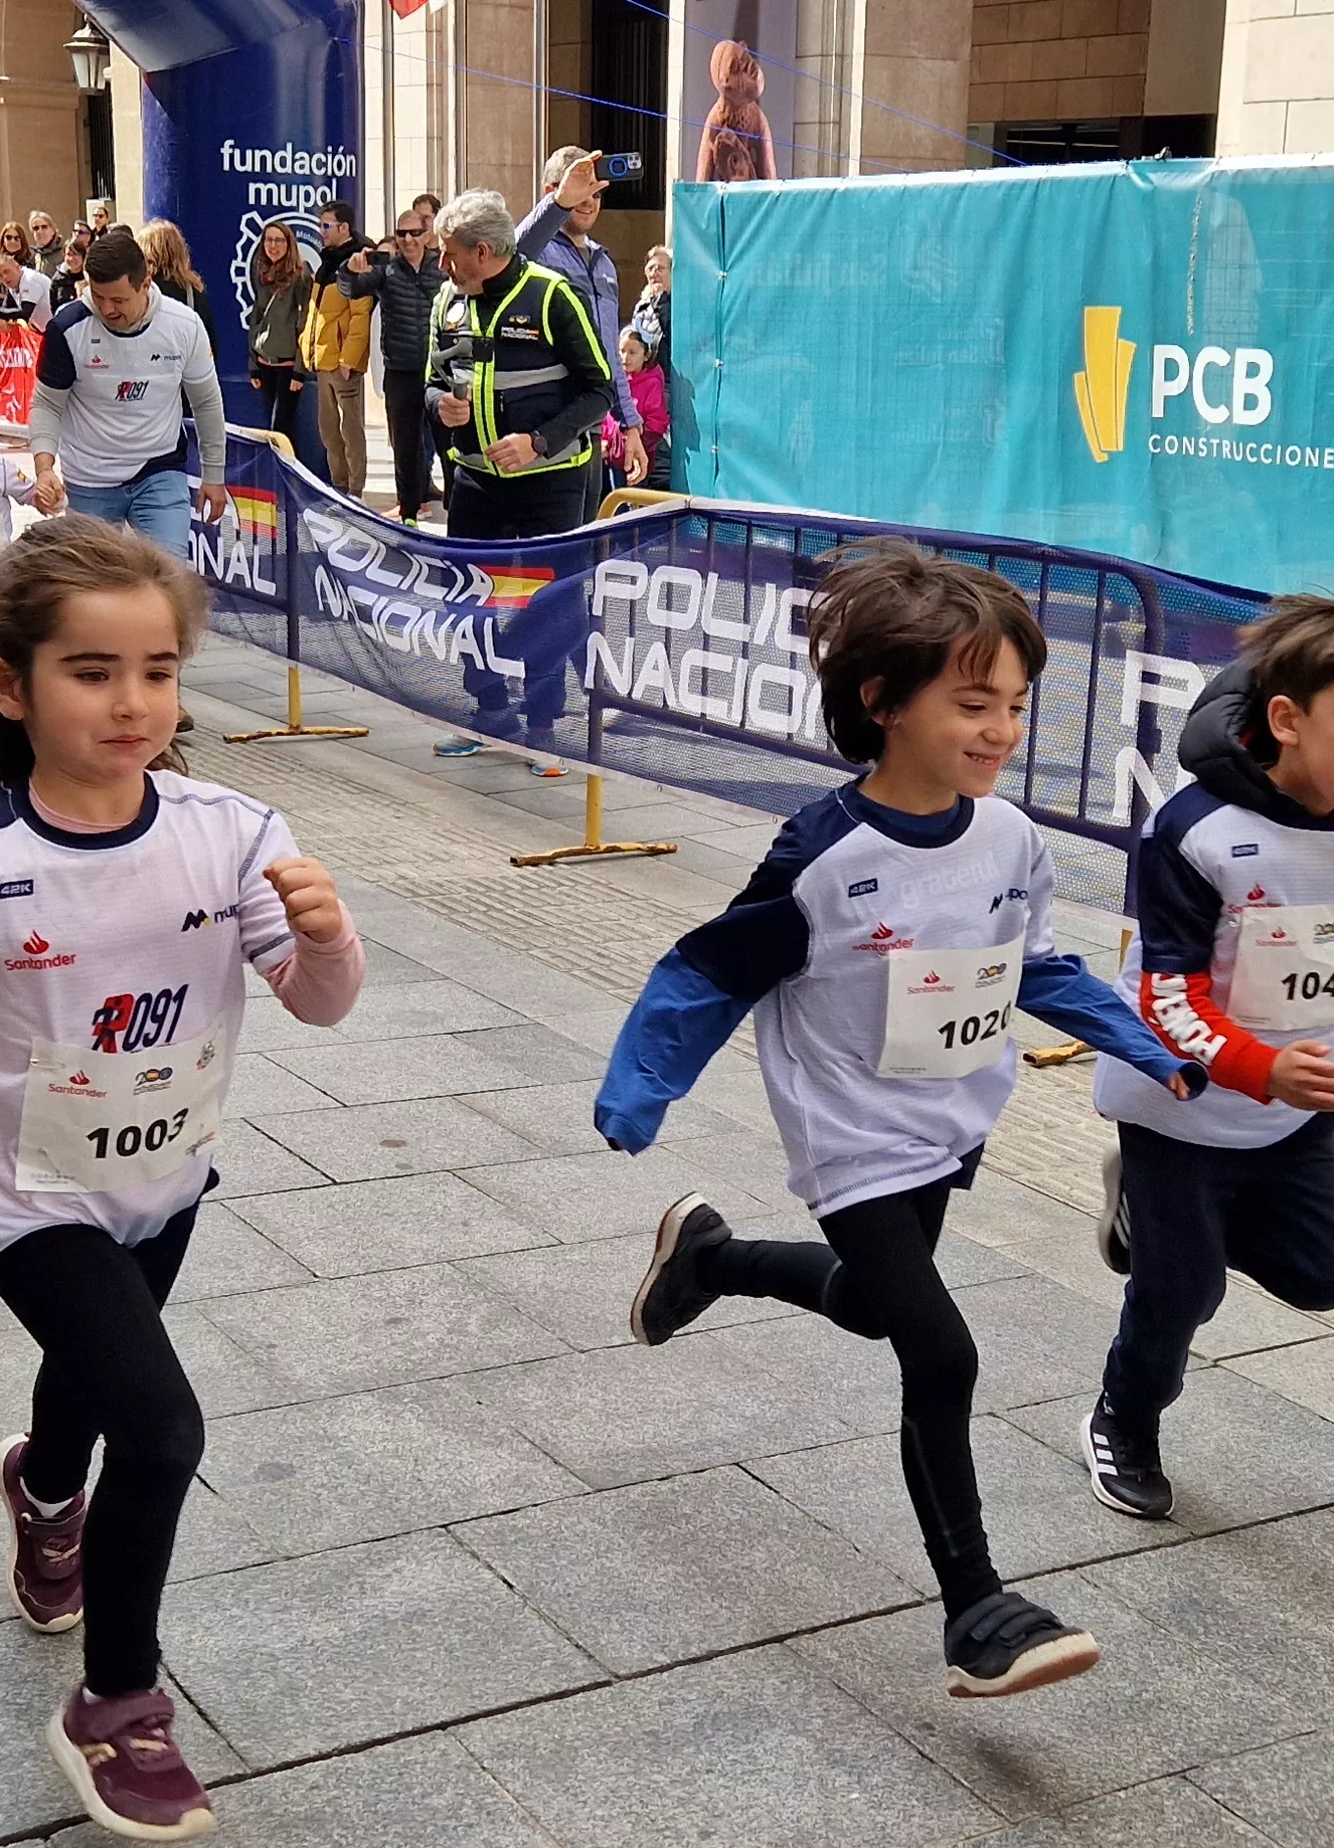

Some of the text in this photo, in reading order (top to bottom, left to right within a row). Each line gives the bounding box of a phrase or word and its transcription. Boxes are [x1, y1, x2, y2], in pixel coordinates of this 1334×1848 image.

[220, 139, 356, 177] fundación
[248, 178, 337, 213] mupol
[1151, 344, 1274, 426] PCB
[315, 565, 525, 679] NACIONAL
[592, 559, 832, 655] POLIC
[584, 631, 823, 742] NACIO
[1, 884, 31, 895] 42K
[4, 953, 77, 971] Santander
[907, 983, 956, 994] Santander
[48, 1083, 107, 1098] Santander
[86, 1107, 189, 1159] 1003
